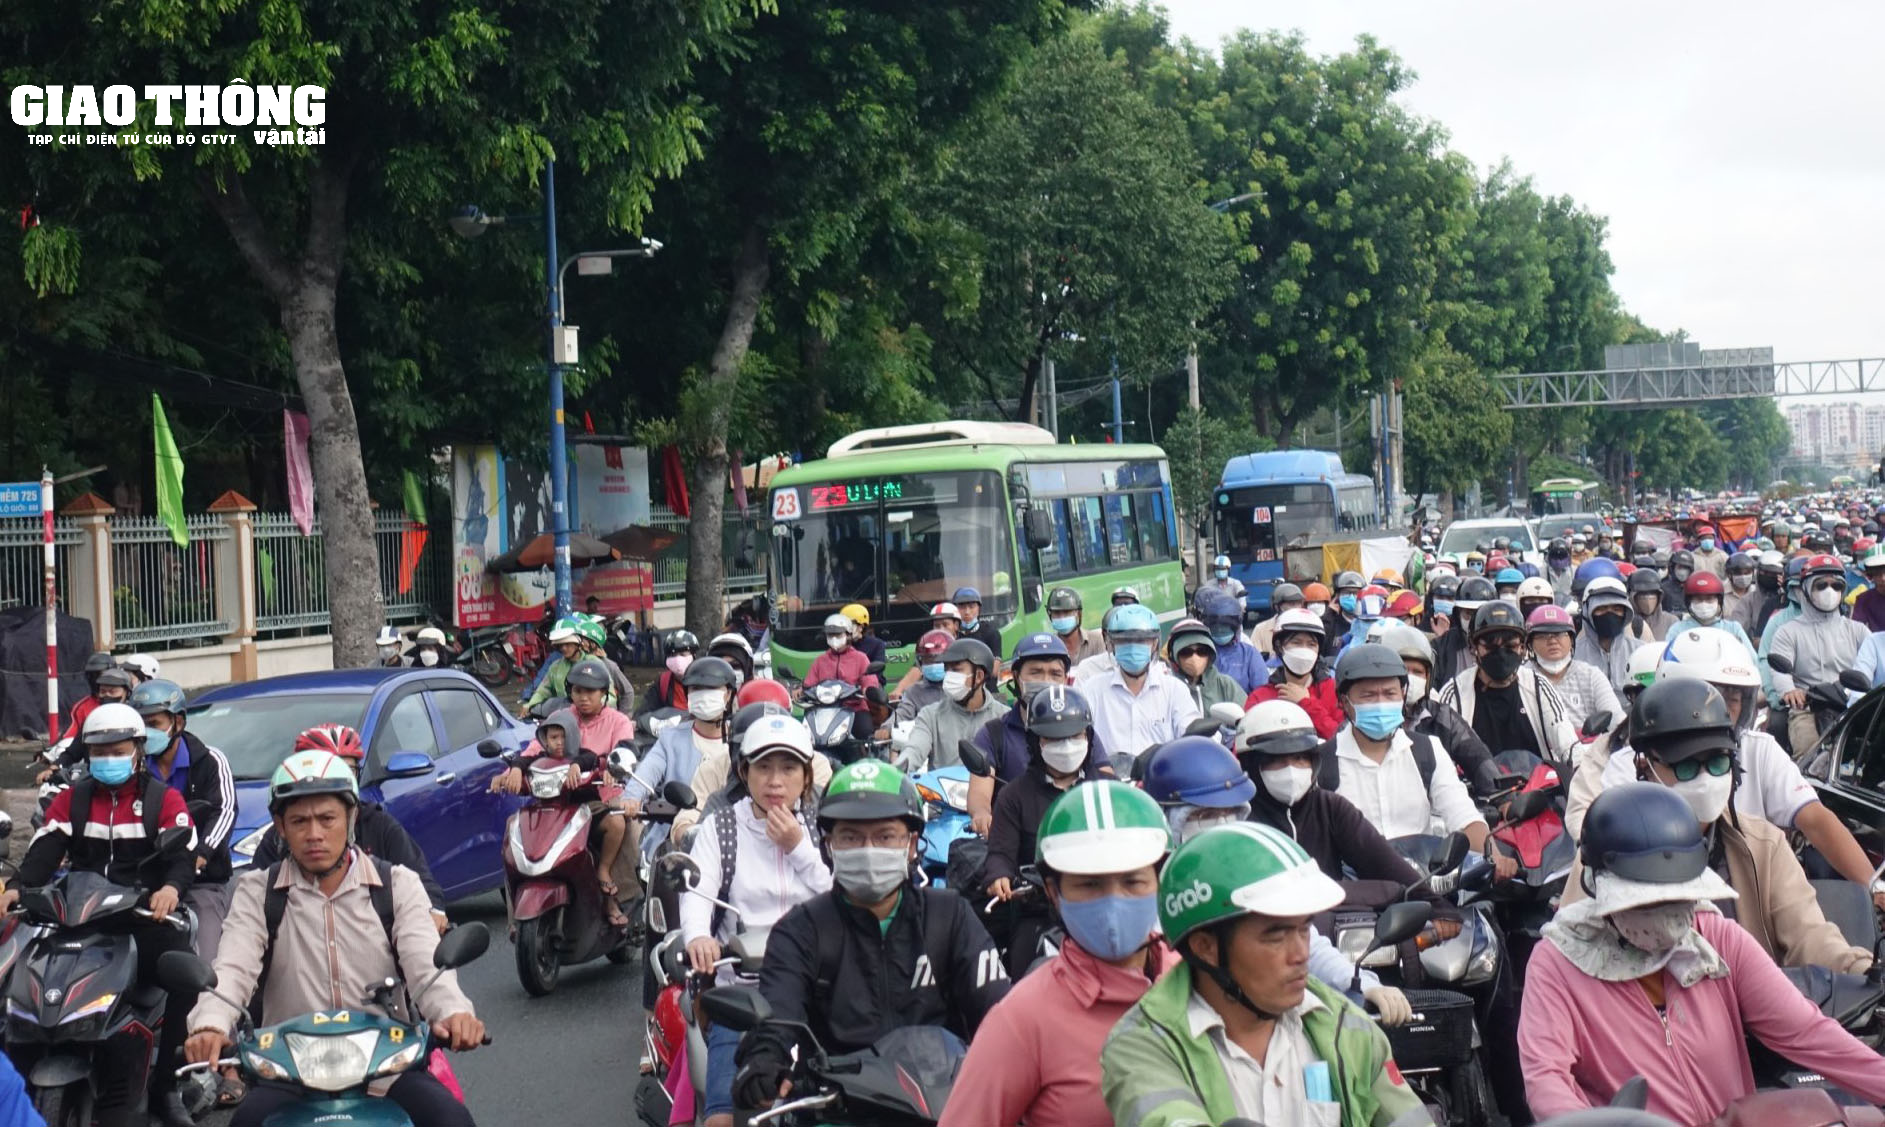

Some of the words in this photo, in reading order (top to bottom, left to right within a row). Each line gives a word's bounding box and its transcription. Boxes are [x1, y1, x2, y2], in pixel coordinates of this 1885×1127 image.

[21, 490, 38, 502] 725
[812, 485, 847, 508] 23
[776, 494, 796, 515] 23
[1256, 509, 1270, 521] 104
[1165, 879, 1213, 917] Grab
[1410, 1025, 1436, 1033] HONDA
[1797, 1074, 1825, 1084] HON
[314, 1114, 353, 1123] HONDA
